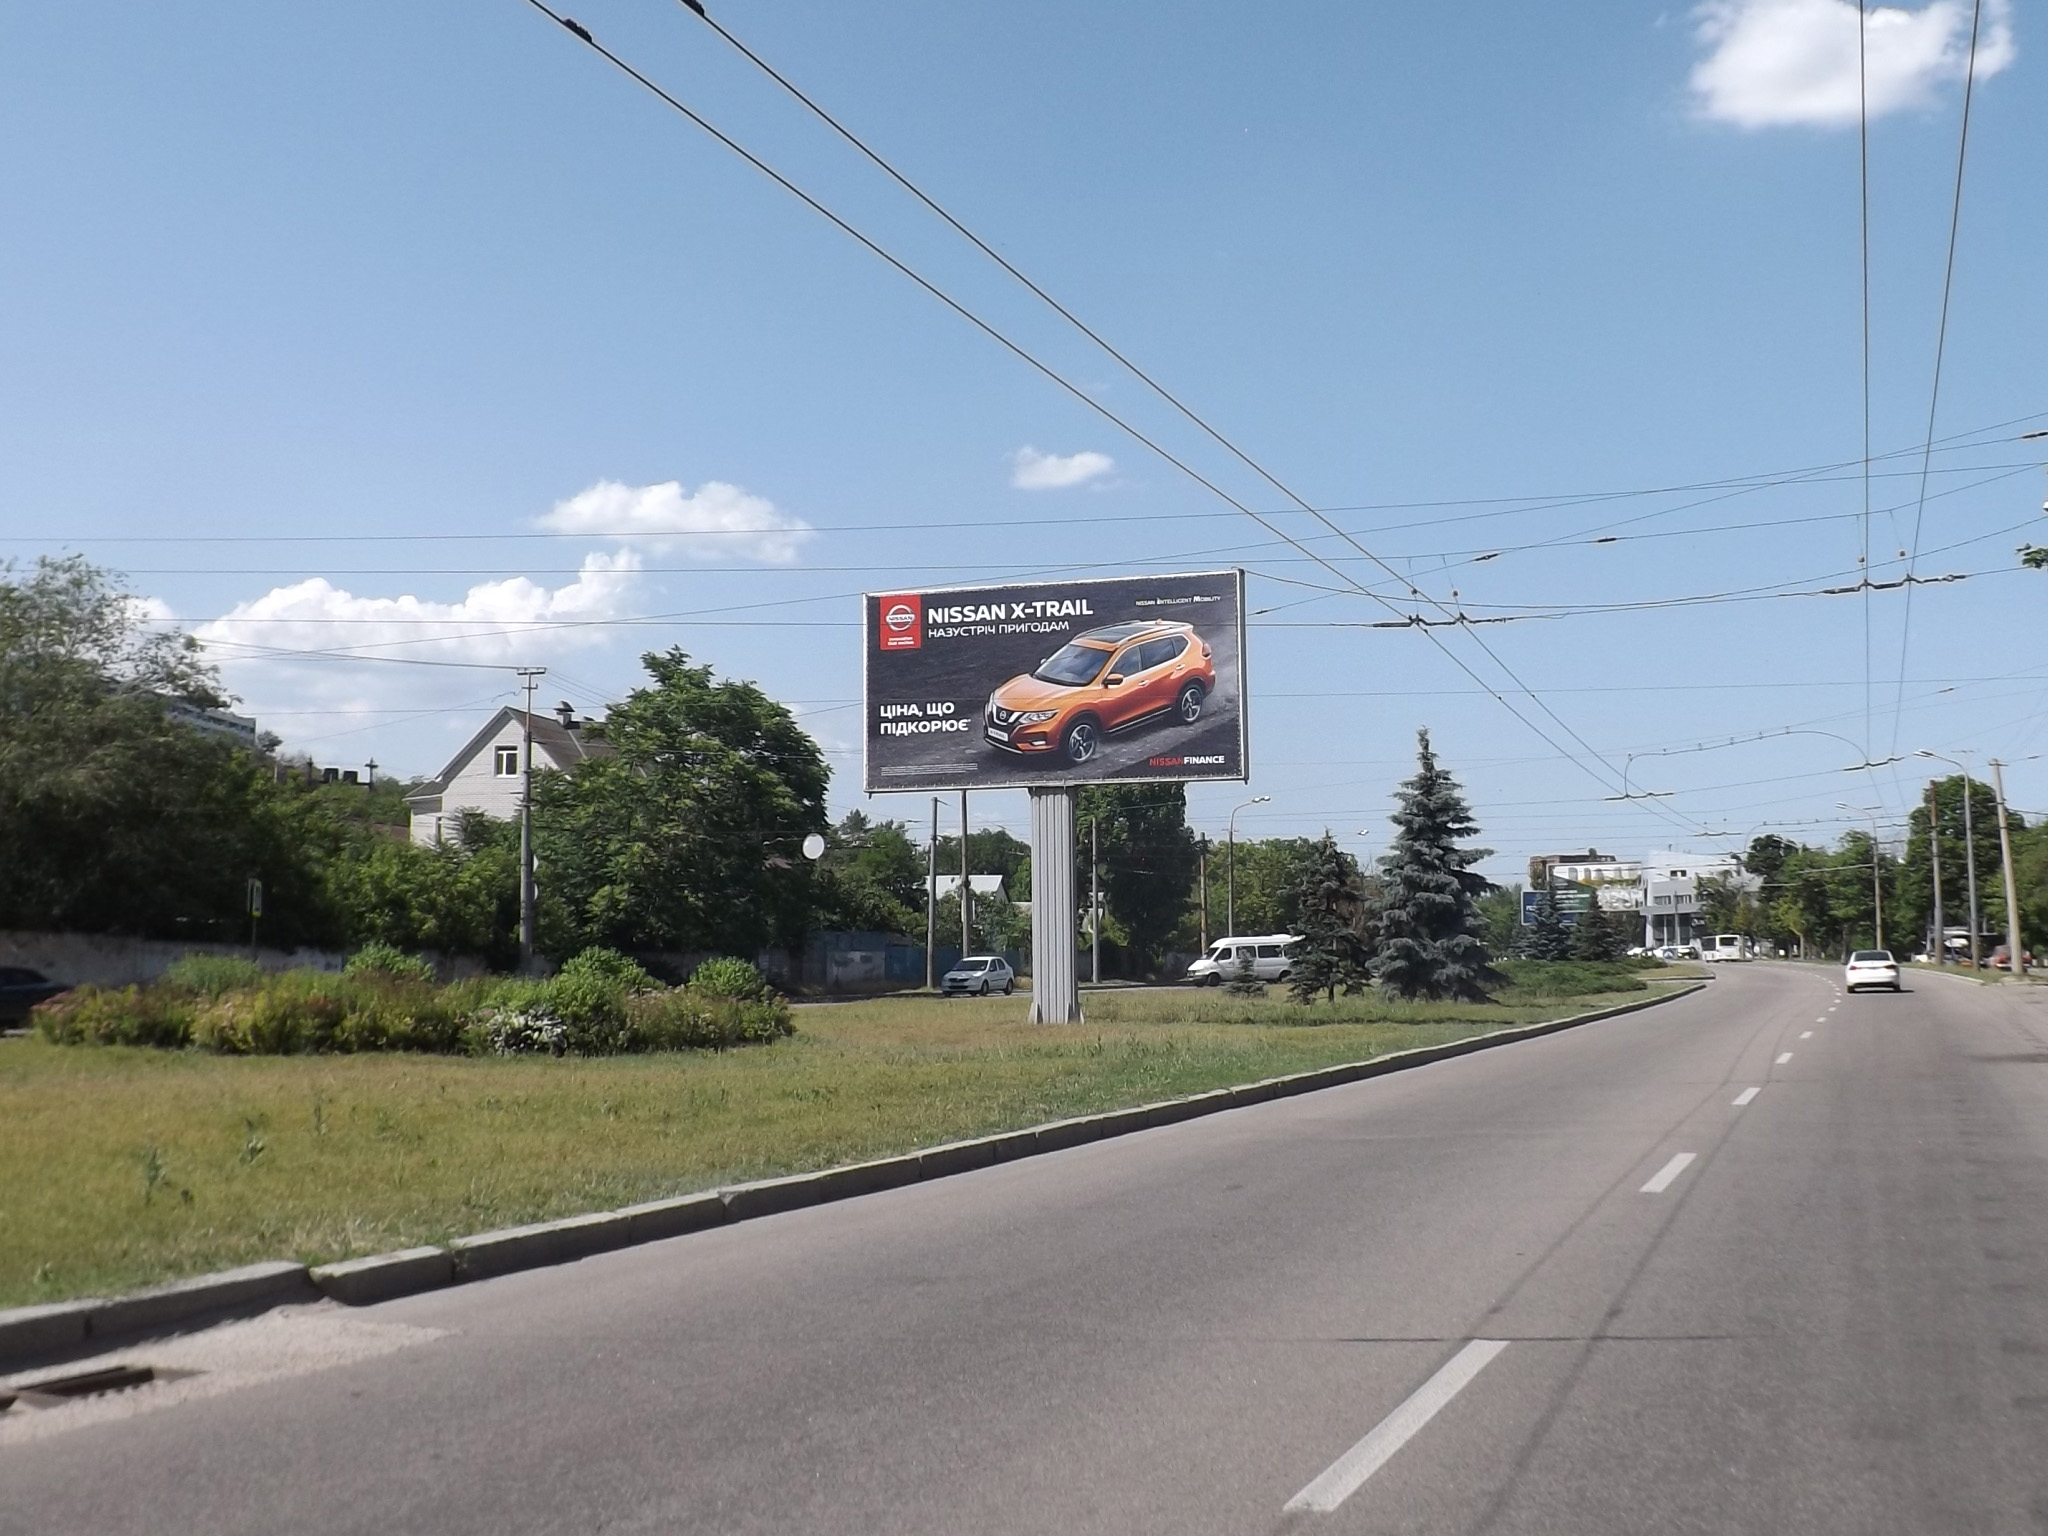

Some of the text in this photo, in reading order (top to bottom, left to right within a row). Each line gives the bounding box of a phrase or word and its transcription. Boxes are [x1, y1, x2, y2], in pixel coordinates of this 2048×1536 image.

[928, 599, 1094, 624] NISSAN X-TRAIL
[928, 621, 1070, 638] НАЗУСТРІЧ ПРИГОДАМ
[880, 702, 955, 719] ЦІНА, ЩО
